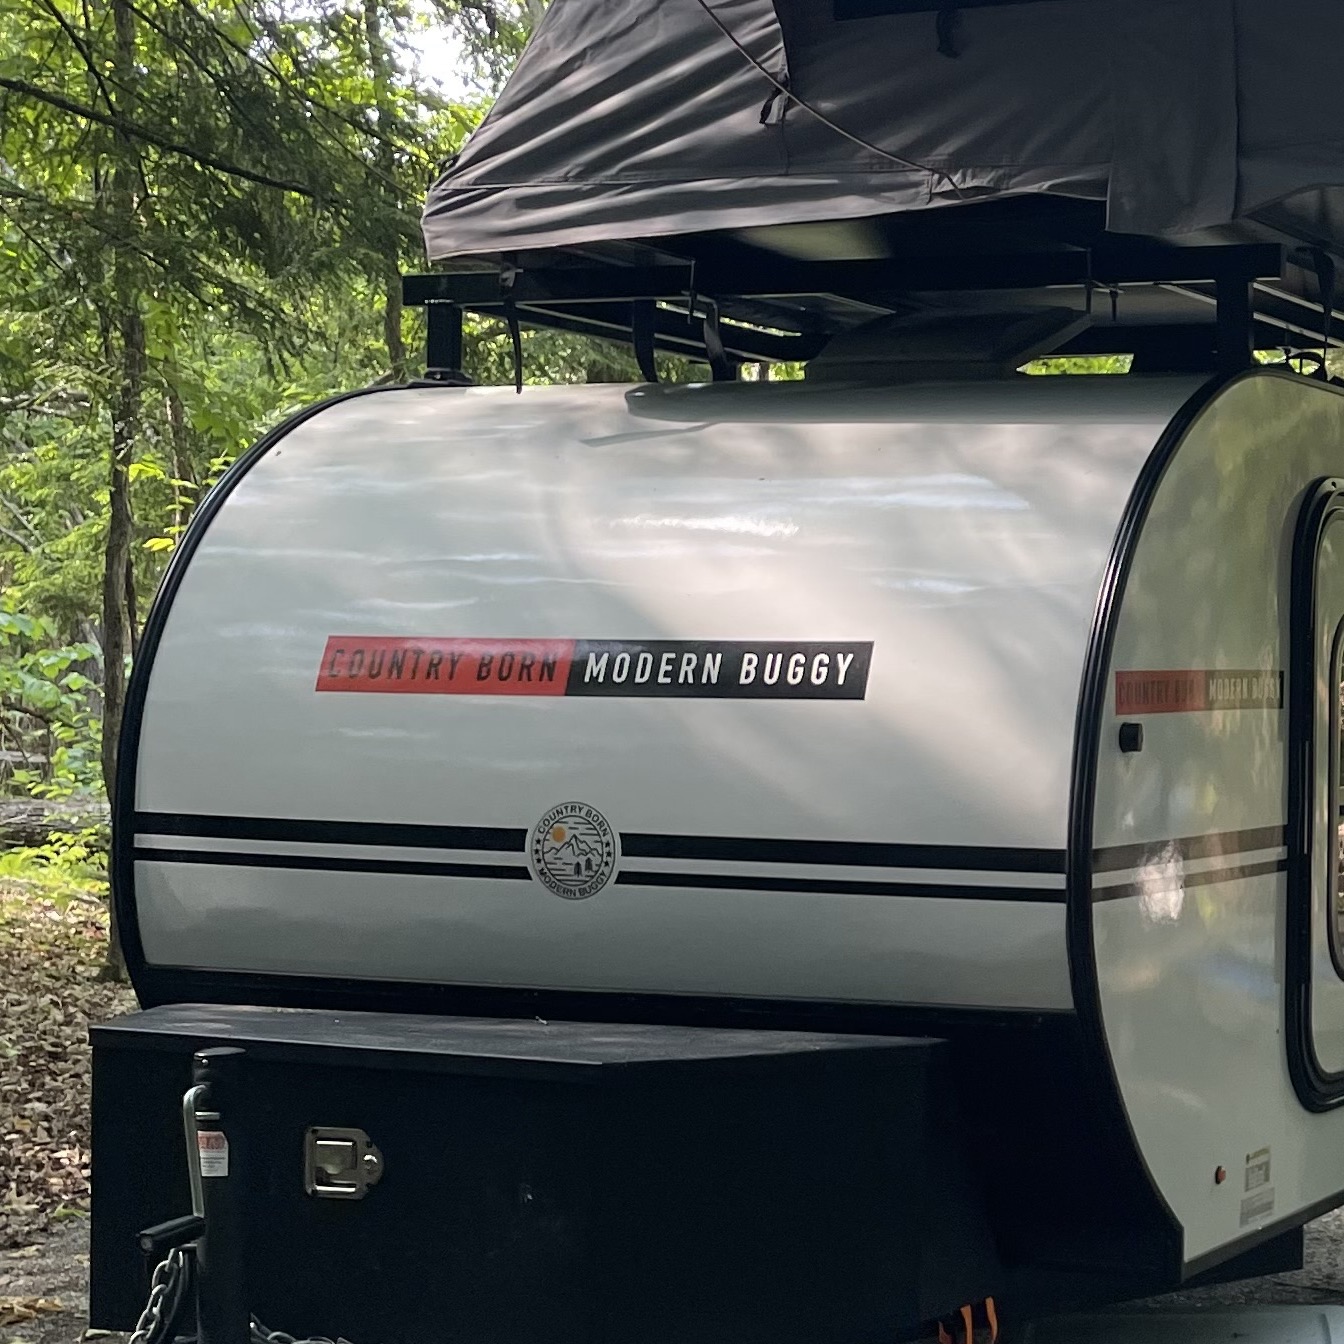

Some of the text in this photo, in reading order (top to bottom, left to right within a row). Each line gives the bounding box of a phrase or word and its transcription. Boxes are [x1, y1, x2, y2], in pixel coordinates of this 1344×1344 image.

[328, 648, 855, 686] COUNTRY BORN MODERN BUGGY
[1209, 677, 1248, 701] MODERN
[538, 804, 610, 838] COUNTRY BORN
[538, 866, 608, 897] MODERN BUGGY
